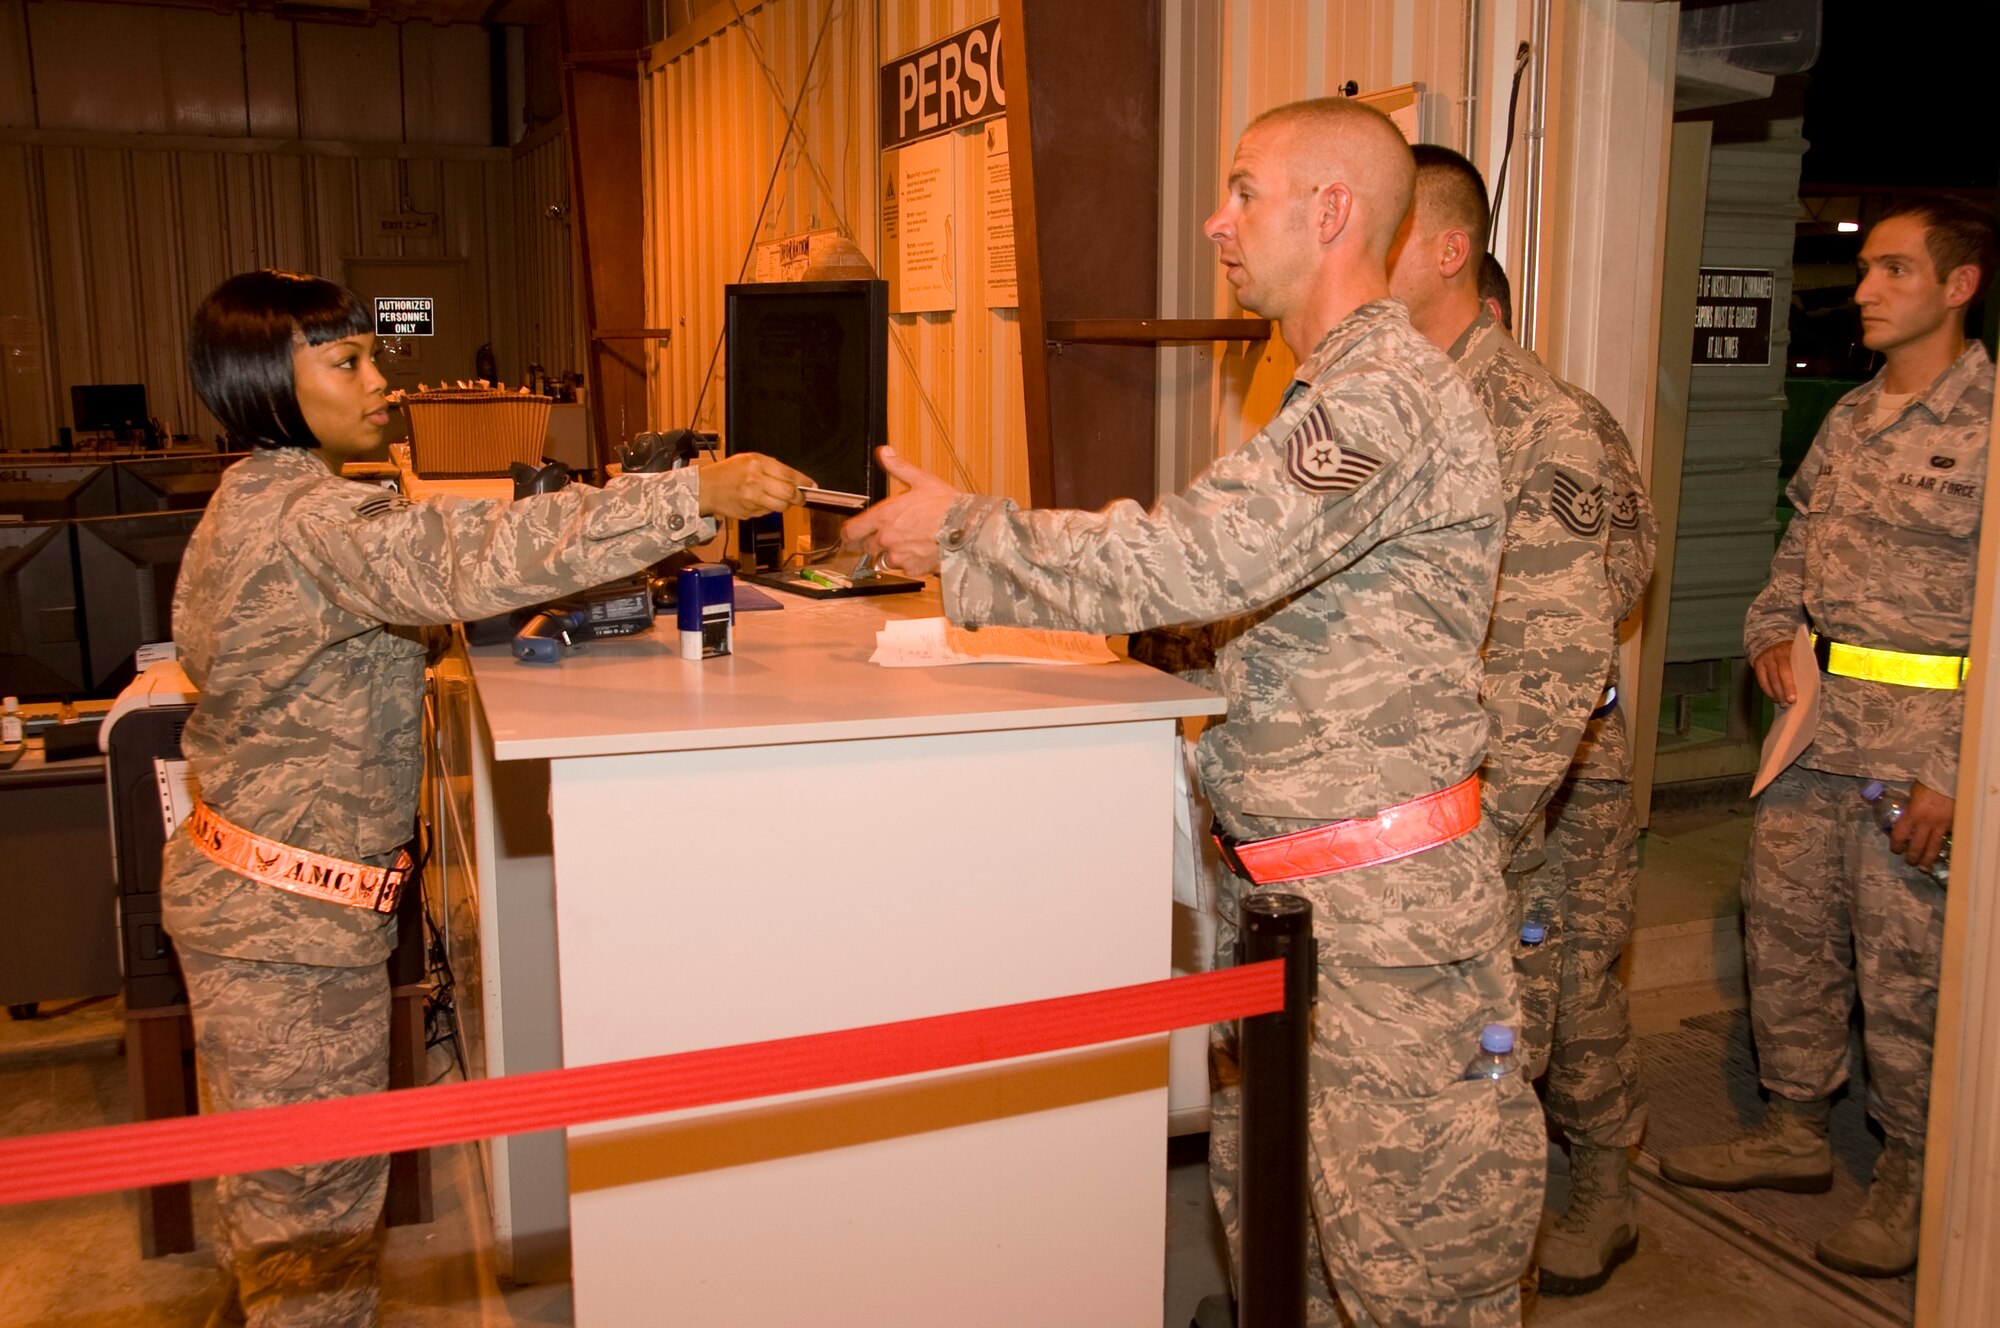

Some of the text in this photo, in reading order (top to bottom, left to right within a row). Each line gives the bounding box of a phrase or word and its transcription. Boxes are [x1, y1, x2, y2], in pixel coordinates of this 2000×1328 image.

[379, 301, 431, 311] AUTHORIZED
[380, 312, 430, 322] PERSONNEL
[1714, 306, 1728, 328] MUST
[1728, 306, 1735, 328] BE
[1735, 307, 1757, 328] GUARDED
[395, 323, 416, 334] ONLY
[1707, 336, 1739, 358] AT ALL TIMES
[1916, 476, 1937, 491] AIR
[1939, 480, 1976, 498] FORCE
[284, 861, 354, 893] AMC
